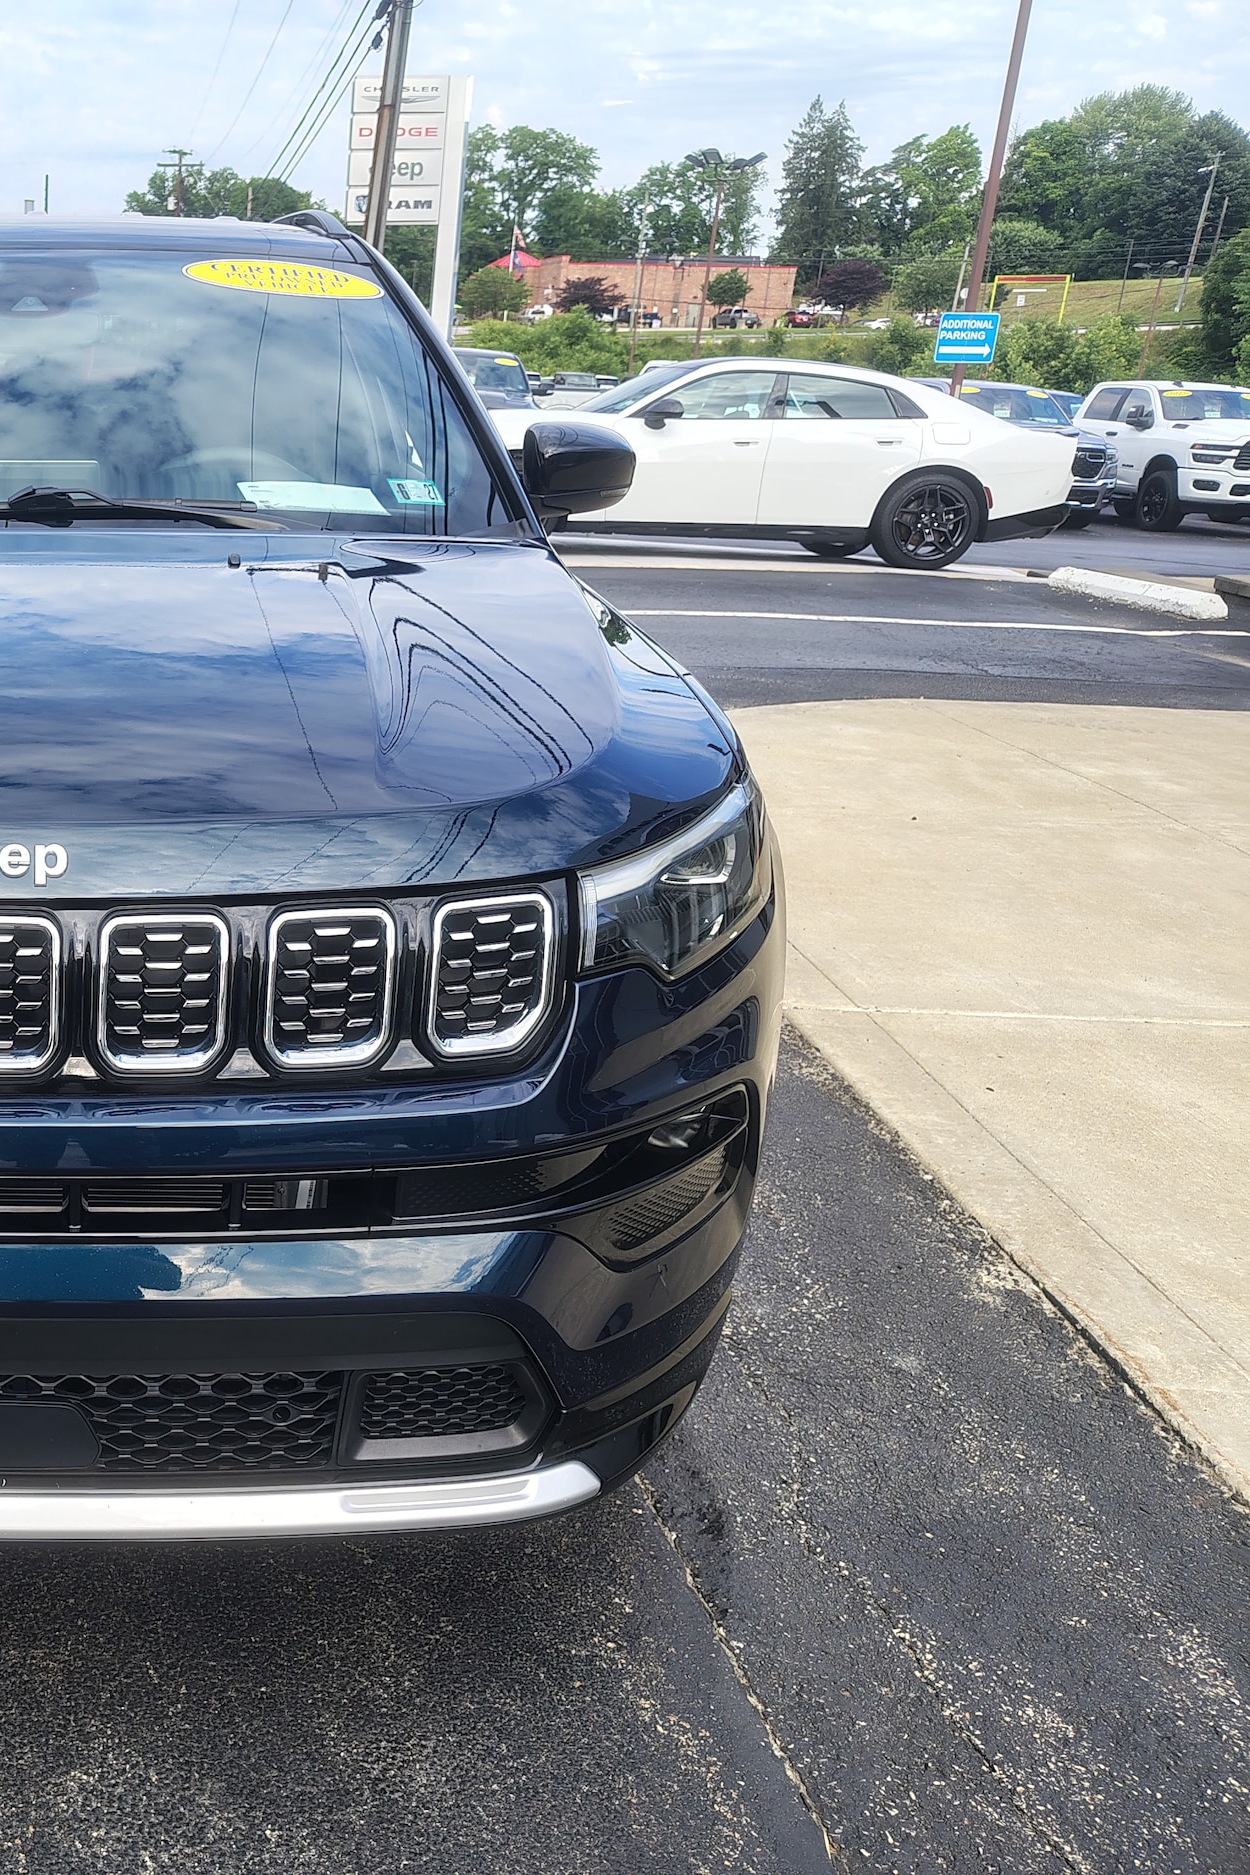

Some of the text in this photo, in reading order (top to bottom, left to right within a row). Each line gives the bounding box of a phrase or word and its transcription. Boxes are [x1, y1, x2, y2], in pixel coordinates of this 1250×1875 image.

[358, 127, 439, 137] DDGE
[210, 263, 350, 283] CERTIFIED
[244, 280, 334, 294] VEHICLE
[941, 319, 994, 329] ADDITIONAL
[939, 331, 986, 340] PARKING
[396, 483, 411, 500] 6
